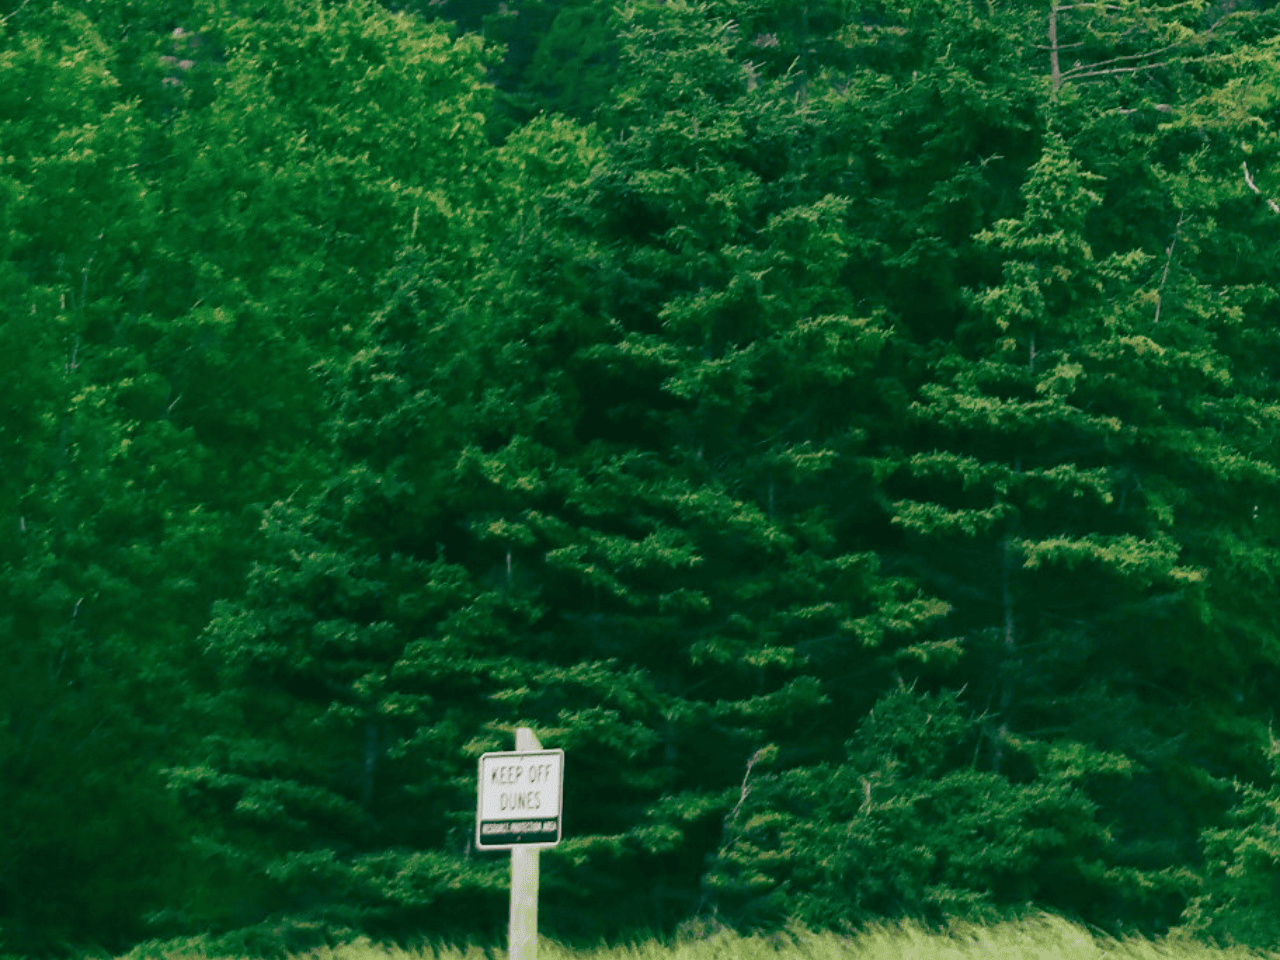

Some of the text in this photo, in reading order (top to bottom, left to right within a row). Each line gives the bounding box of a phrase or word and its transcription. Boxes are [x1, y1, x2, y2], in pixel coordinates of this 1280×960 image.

[491, 763, 553, 784] KEEP OFF
[501, 791, 541, 810] DUNES
